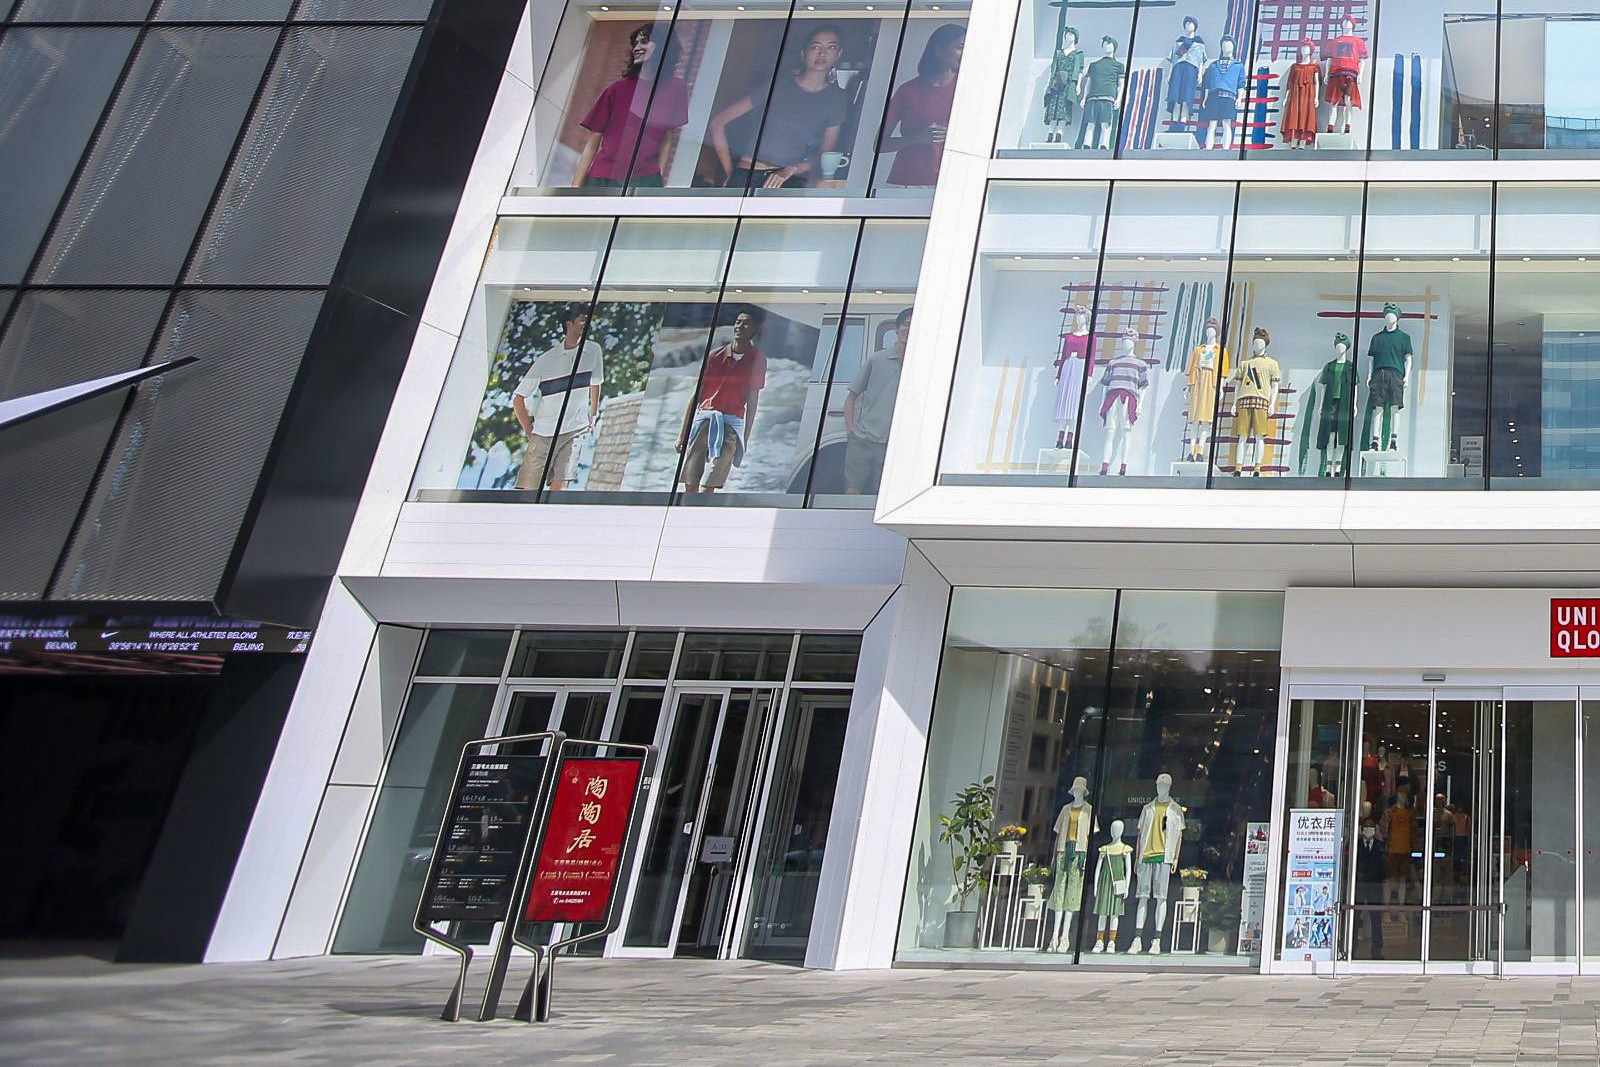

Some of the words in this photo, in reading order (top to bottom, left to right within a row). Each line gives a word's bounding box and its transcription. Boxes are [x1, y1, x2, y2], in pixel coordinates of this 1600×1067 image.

[1557, 606, 1597, 626] UNI
[150, 631, 175, 639] WHERE
[175, 631, 190, 639] ALL
[190, 631, 226, 639] ATHLETES
[227, 631, 258, 639] BELONG
[1557, 630, 1600, 653] QLO
[233, 642, 264, 651] BEIJING
[566, 776, 608, 853] 陶陶居
[1298, 816, 1336, 830] 优衣库
